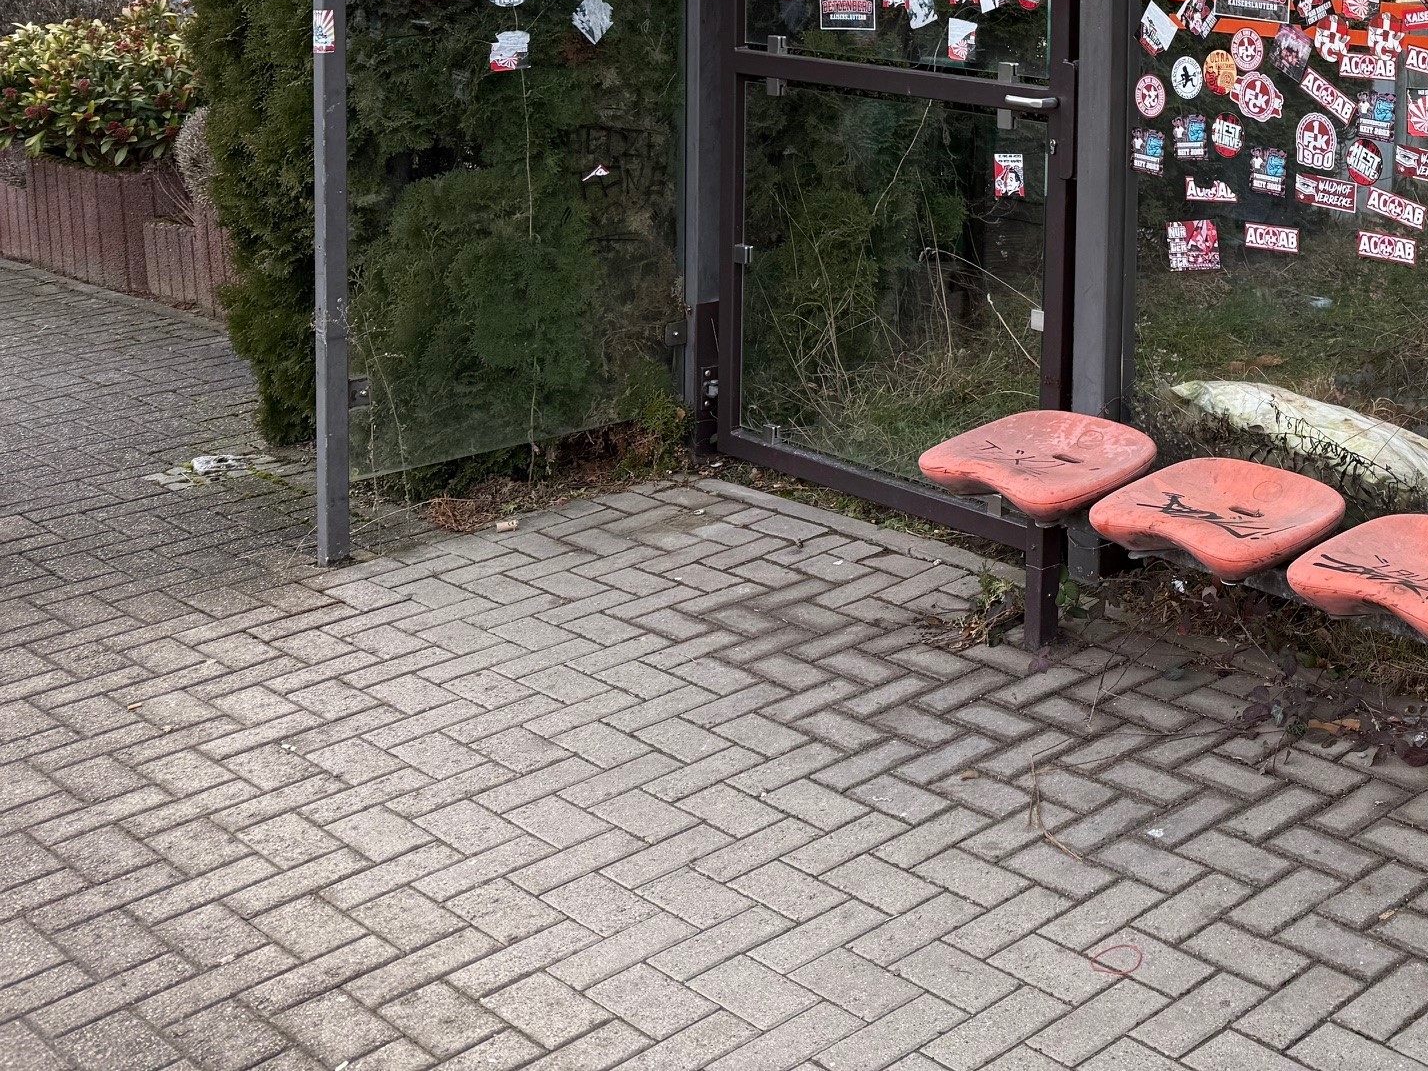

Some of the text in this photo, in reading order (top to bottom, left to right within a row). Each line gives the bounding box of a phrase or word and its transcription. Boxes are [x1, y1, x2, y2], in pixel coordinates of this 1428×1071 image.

[821, 0, 872, 14] BETZENBERG
[1228, 0, 1278, 10] KAISERSLAUTERN
[1298, 147, 1334, 169] 1900
[1318, 181, 1352, 195] WALDHOF
[1314, 193, 1353, 207] VERRECKE
[1168, 227, 1186, 239] NUR
[1170, 257, 1188, 268] FCK
